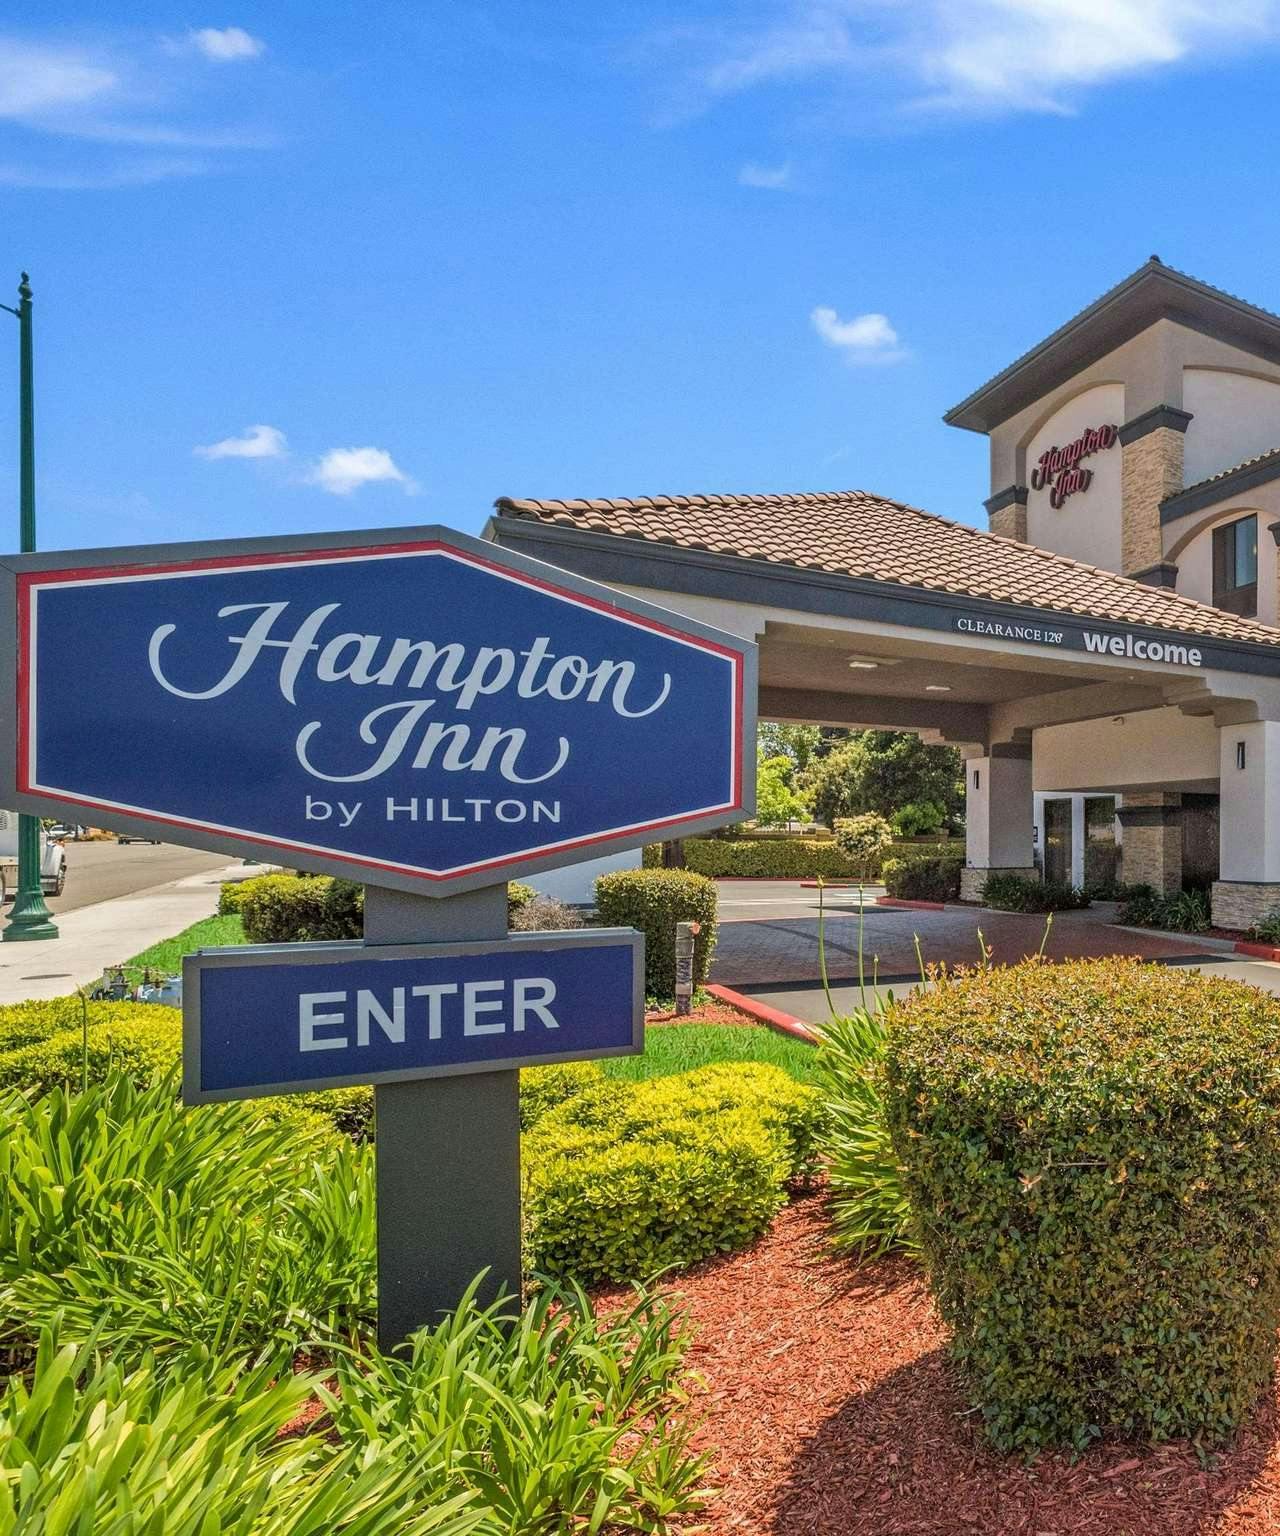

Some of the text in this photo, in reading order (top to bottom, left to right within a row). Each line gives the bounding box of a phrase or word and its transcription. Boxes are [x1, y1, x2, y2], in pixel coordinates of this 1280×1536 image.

[1031, 424, 1118, 491] Hampton
[1050, 468, 1094, 509] Inn
[149, 602, 671, 717] Hampton
[957, 618, 1041, 641] CLEARANCE
[296, 700, 569, 783] Inn
[305, 796, 560, 827] by HILTON
[300, 978, 559, 1051] ENTER
